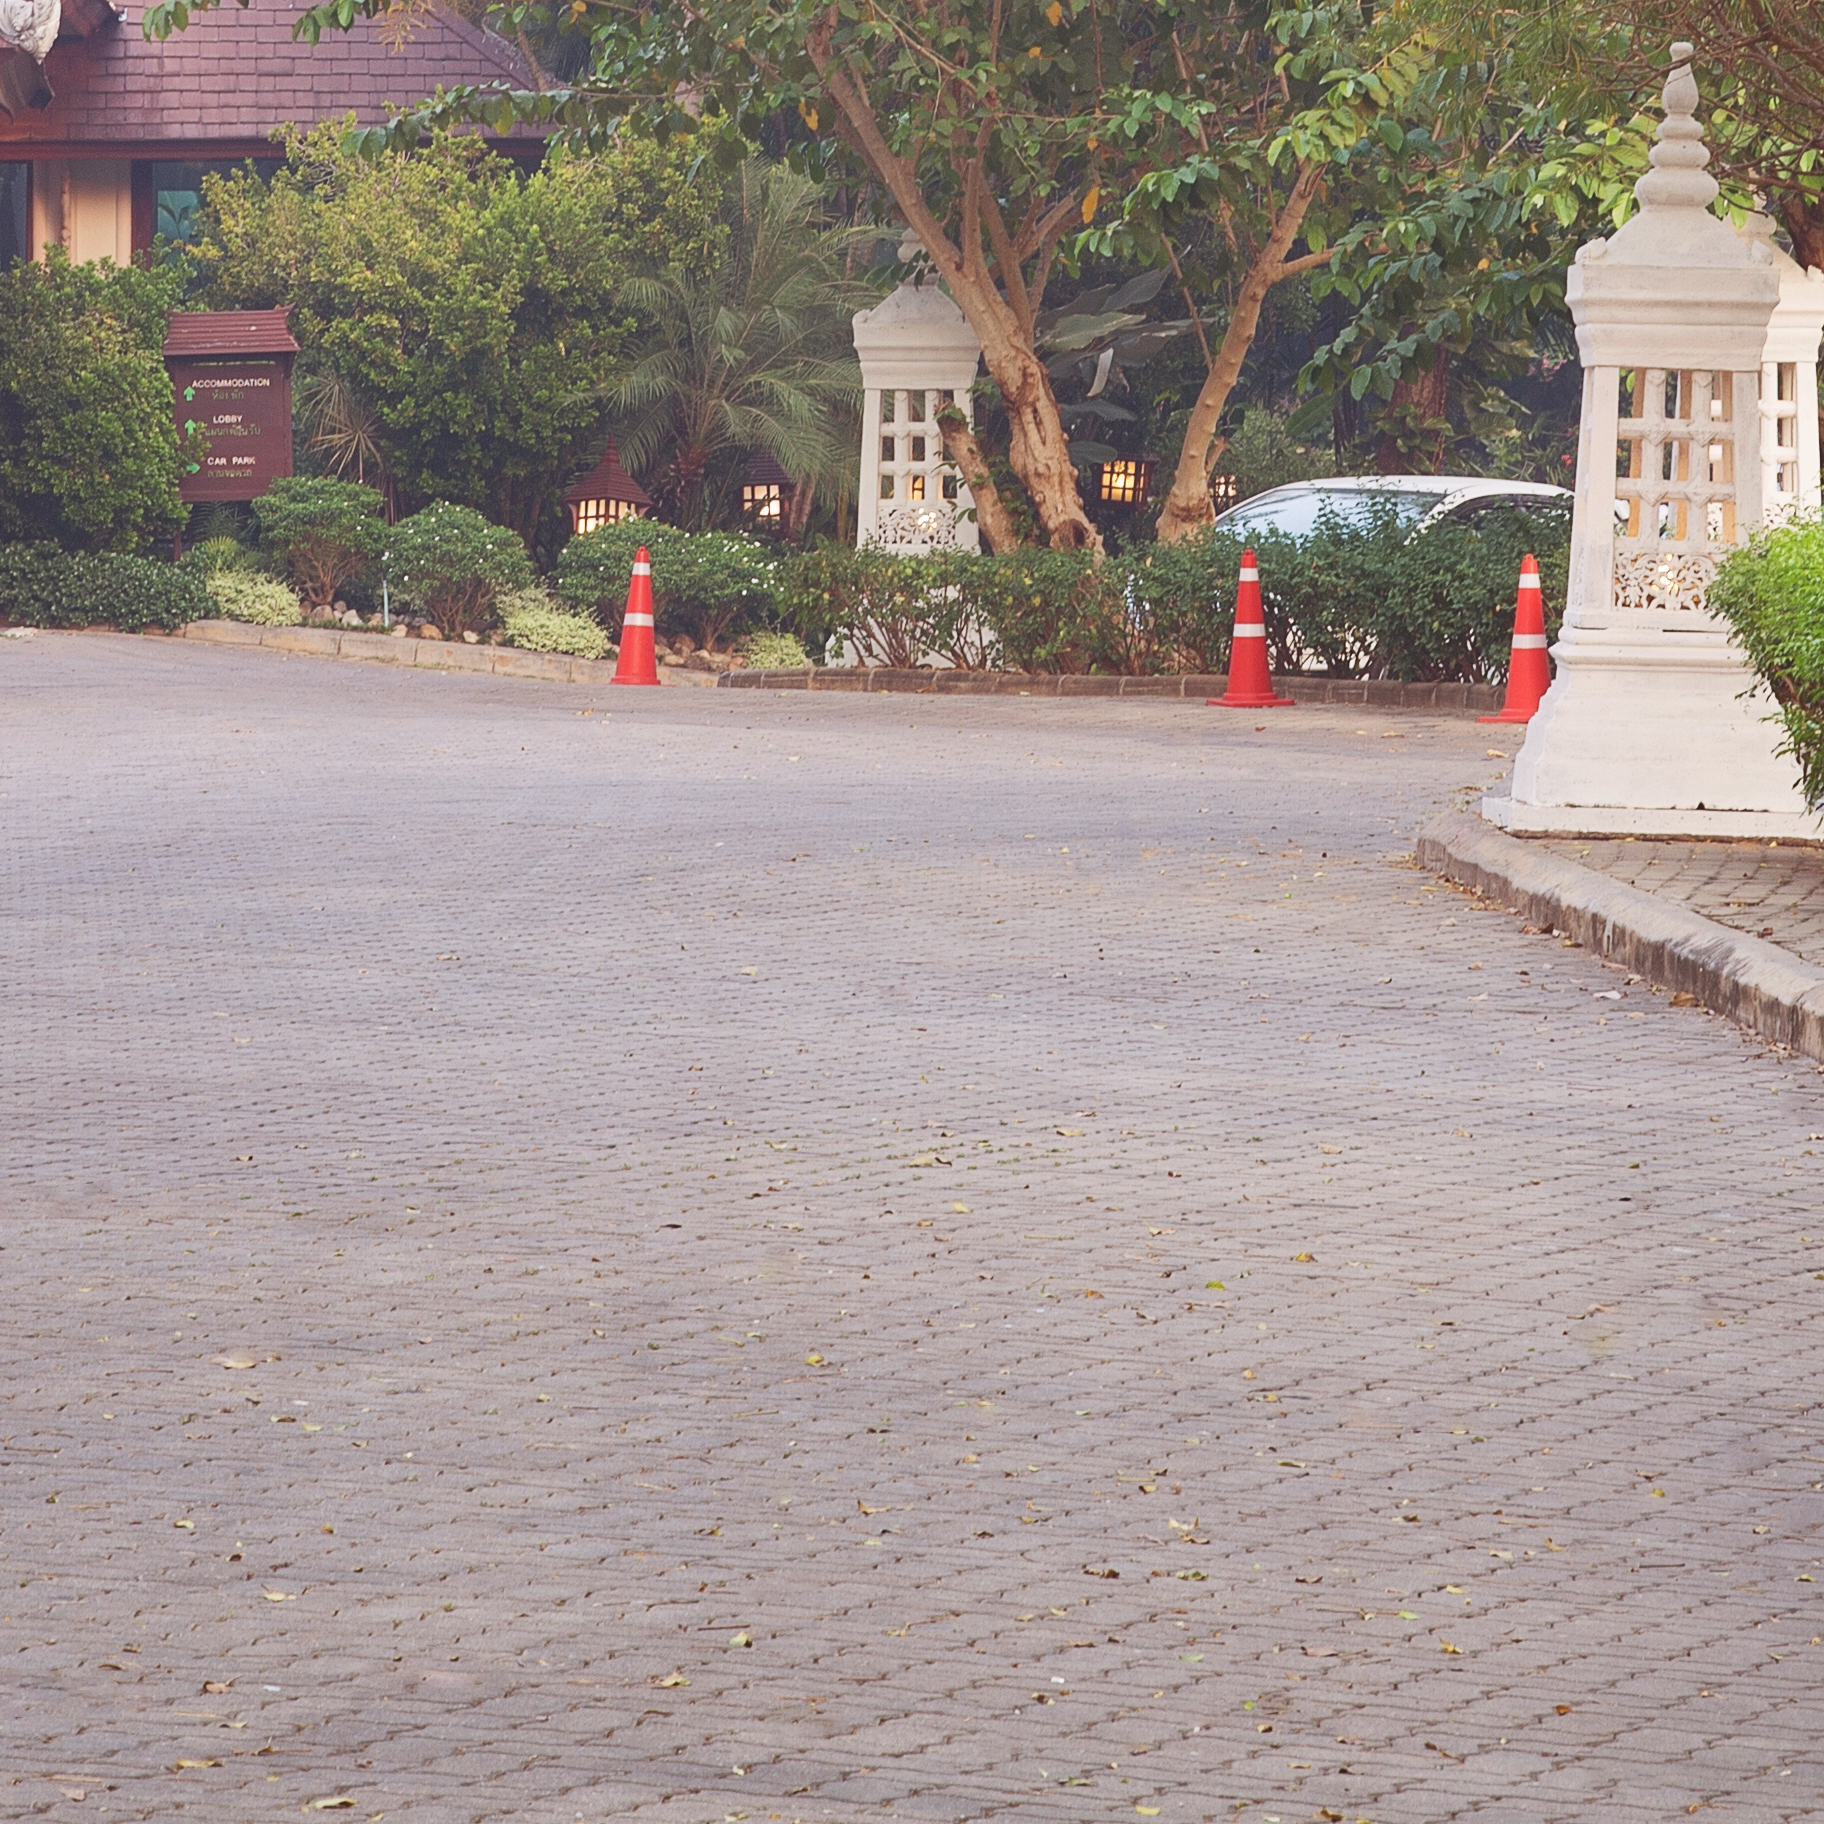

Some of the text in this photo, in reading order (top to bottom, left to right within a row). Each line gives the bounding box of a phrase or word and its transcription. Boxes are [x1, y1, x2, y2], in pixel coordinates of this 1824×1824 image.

[192, 378, 270, 388] ACCOMMODATION
[213, 414, 243, 424] LOBBY
[207, 456, 256, 466] CAR PARK
